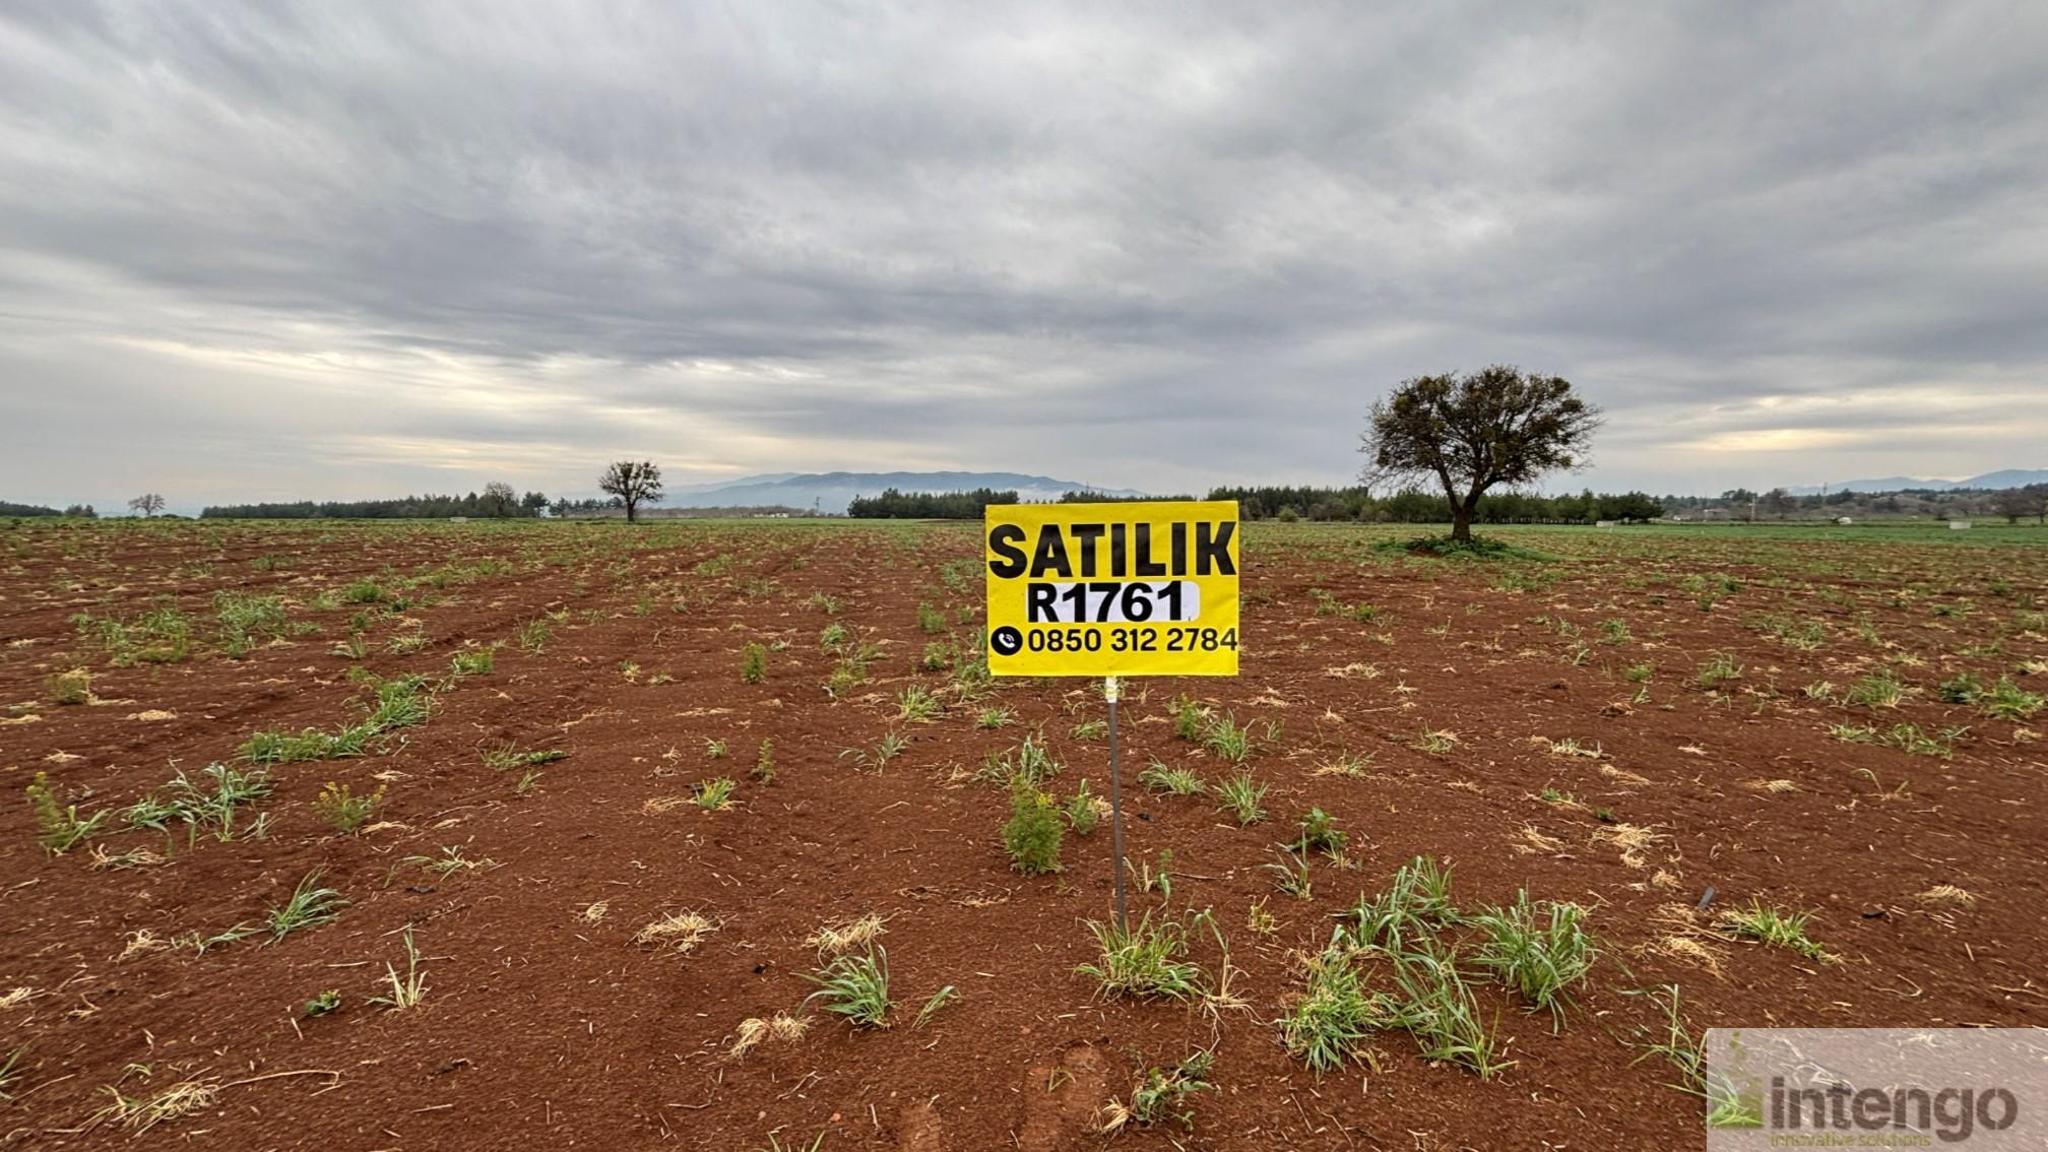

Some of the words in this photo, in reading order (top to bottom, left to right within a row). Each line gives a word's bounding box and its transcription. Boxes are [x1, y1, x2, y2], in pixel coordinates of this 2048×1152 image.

[988, 521, 1237, 579] SATILIK
[1027, 580, 1182, 623] R1761
[1028, 628, 1102, 651] 0850
[1111, 628, 1157, 651] 312
[1167, 628, 1238, 651] 2784
